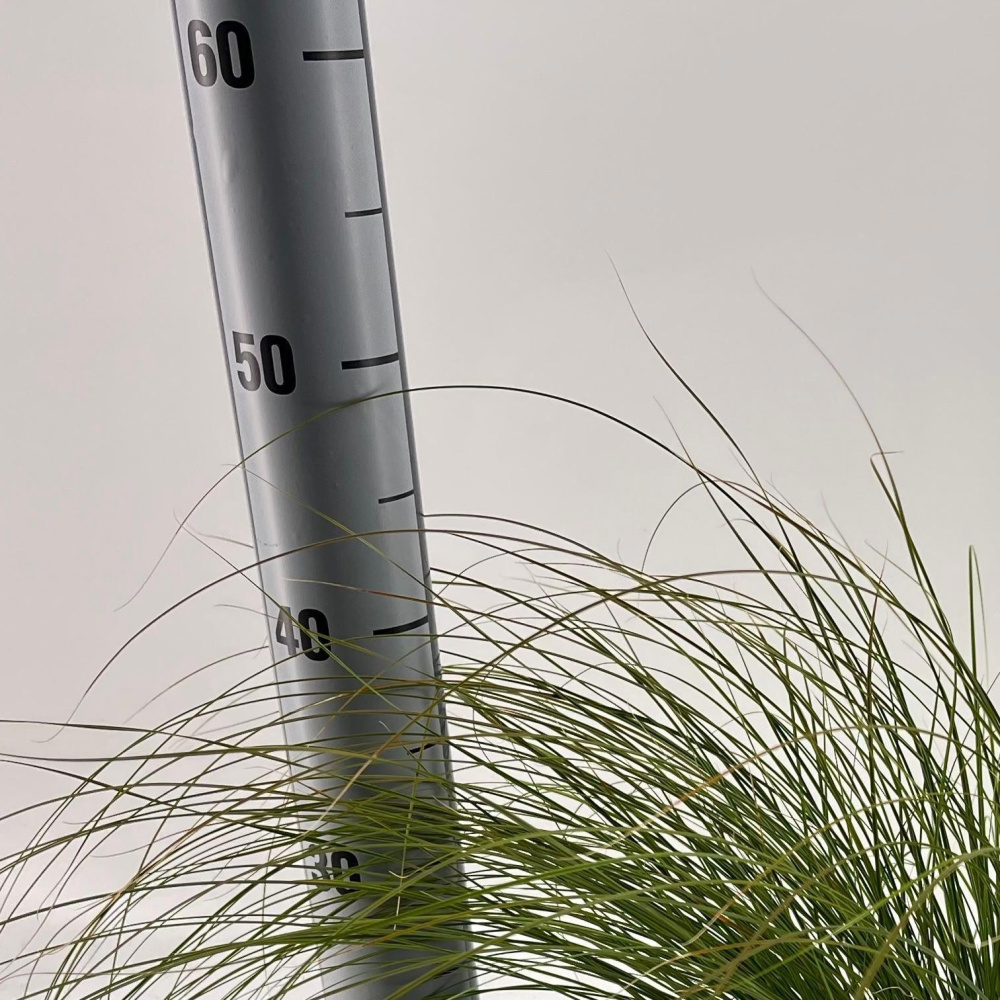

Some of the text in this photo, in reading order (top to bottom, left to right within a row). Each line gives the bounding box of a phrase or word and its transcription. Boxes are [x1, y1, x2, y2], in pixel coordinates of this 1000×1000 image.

[187, 19, 255, 89] 60
[232, 330, 297, 396] 50
[275, 605, 332, 662] 40
